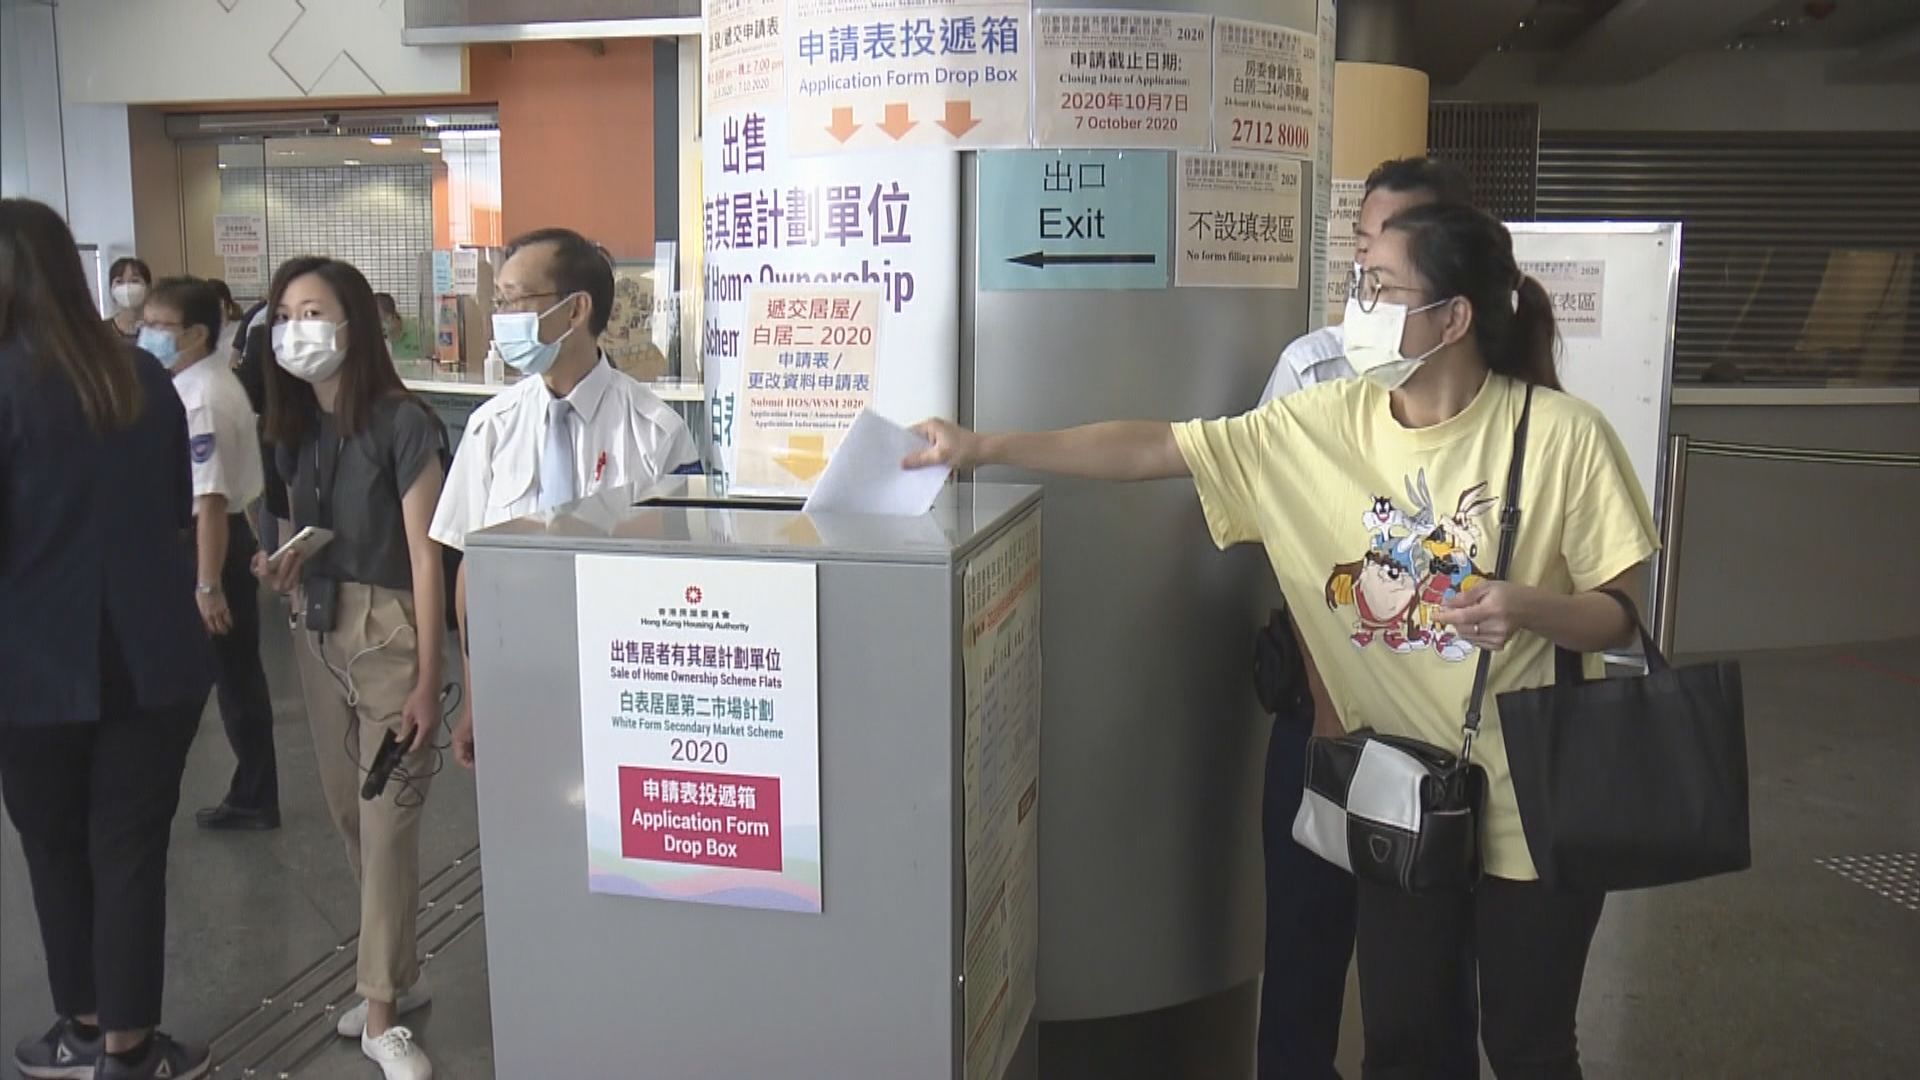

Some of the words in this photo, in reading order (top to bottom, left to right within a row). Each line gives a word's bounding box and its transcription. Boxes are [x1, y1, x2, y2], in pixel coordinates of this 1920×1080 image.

[799, 16, 1019, 65] 申請表投遞箱
[1177, 28, 1204, 41] 2020
[1070, 51, 1182, 71] 申請截止日期:
[799, 71, 882, 96] Application
[887, 69, 930, 86] Form
[936, 67, 979, 87] Drop
[985, 66, 1017, 82] Box
[1059, 73, 1097, 84] Closing
[1100, 74, 1121, 84] Date
[1124, 73, 1134, 84] of
[1061, 92, 1188, 112] 2020年10月7日
[1075, 116, 1083, 129] 7
[1088, 116, 1142, 130] October
[1146, 118, 1178, 131] 2020
[1232, 118, 1273, 144] 2712
[1278, 123, 1309, 149] 8000
[722, 112, 766, 174] 出售
[1044, 160, 1105, 192] 出口
[1281, 173, 1297, 185] 2020
[1040, 208, 1105, 239] Exit
[1188, 210, 1295, 243] 不設填表區
[1187, 250, 1200, 260] No
[1202, 251, 1226, 261] forms
[767, 300, 862, 320] 遞交居屋/
[753, 325, 814, 346] 白居二
[821, 326, 872, 346] 2020
[779, 352, 829, 369] 申請表
[833, 353, 842, 370] /
[748, 372, 869, 391] 更改資料申請表
[751, 397, 783, 408] Submit
[787, 397, 839, 409] HOS/WSM
[842, 399, 864, 409] 2020
[641, 618, 660, 627] Hong
[662, 618, 682, 629] Kong
[683, 620, 714, 630] Housing
[715, 622, 749, 632] Authority
[611, 638, 781, 672] 出售居者有其屋計劃單位
[610, 667, 629, 679] Sale
[631, 667, 641, 679] of
[643, 668, 669, 681] Home
[671, 670, 718, 687] Ownership
[720, 674, 756, 687] Scheme
[759, 676, 782, 689] Flats
[620, 689, 774, 722] 白表居屋第二市場計劃
[611, 716, 637, 728] White
[639, 718, 662, 730] Form
[664, 720, 710, 737] Secondary
[713, 723, 744, 737] Market
[747, 726, 784, 739] Scheme
[670, 738, 728, 764] 2020
[643, 778, 756, 810] 申請表投遞箱
[632, 808, 722, 833] Application
[726, 816, 769, 837] Form
[664, 835, 702, 858] Drop
[706, 838, 737, 858] Box
